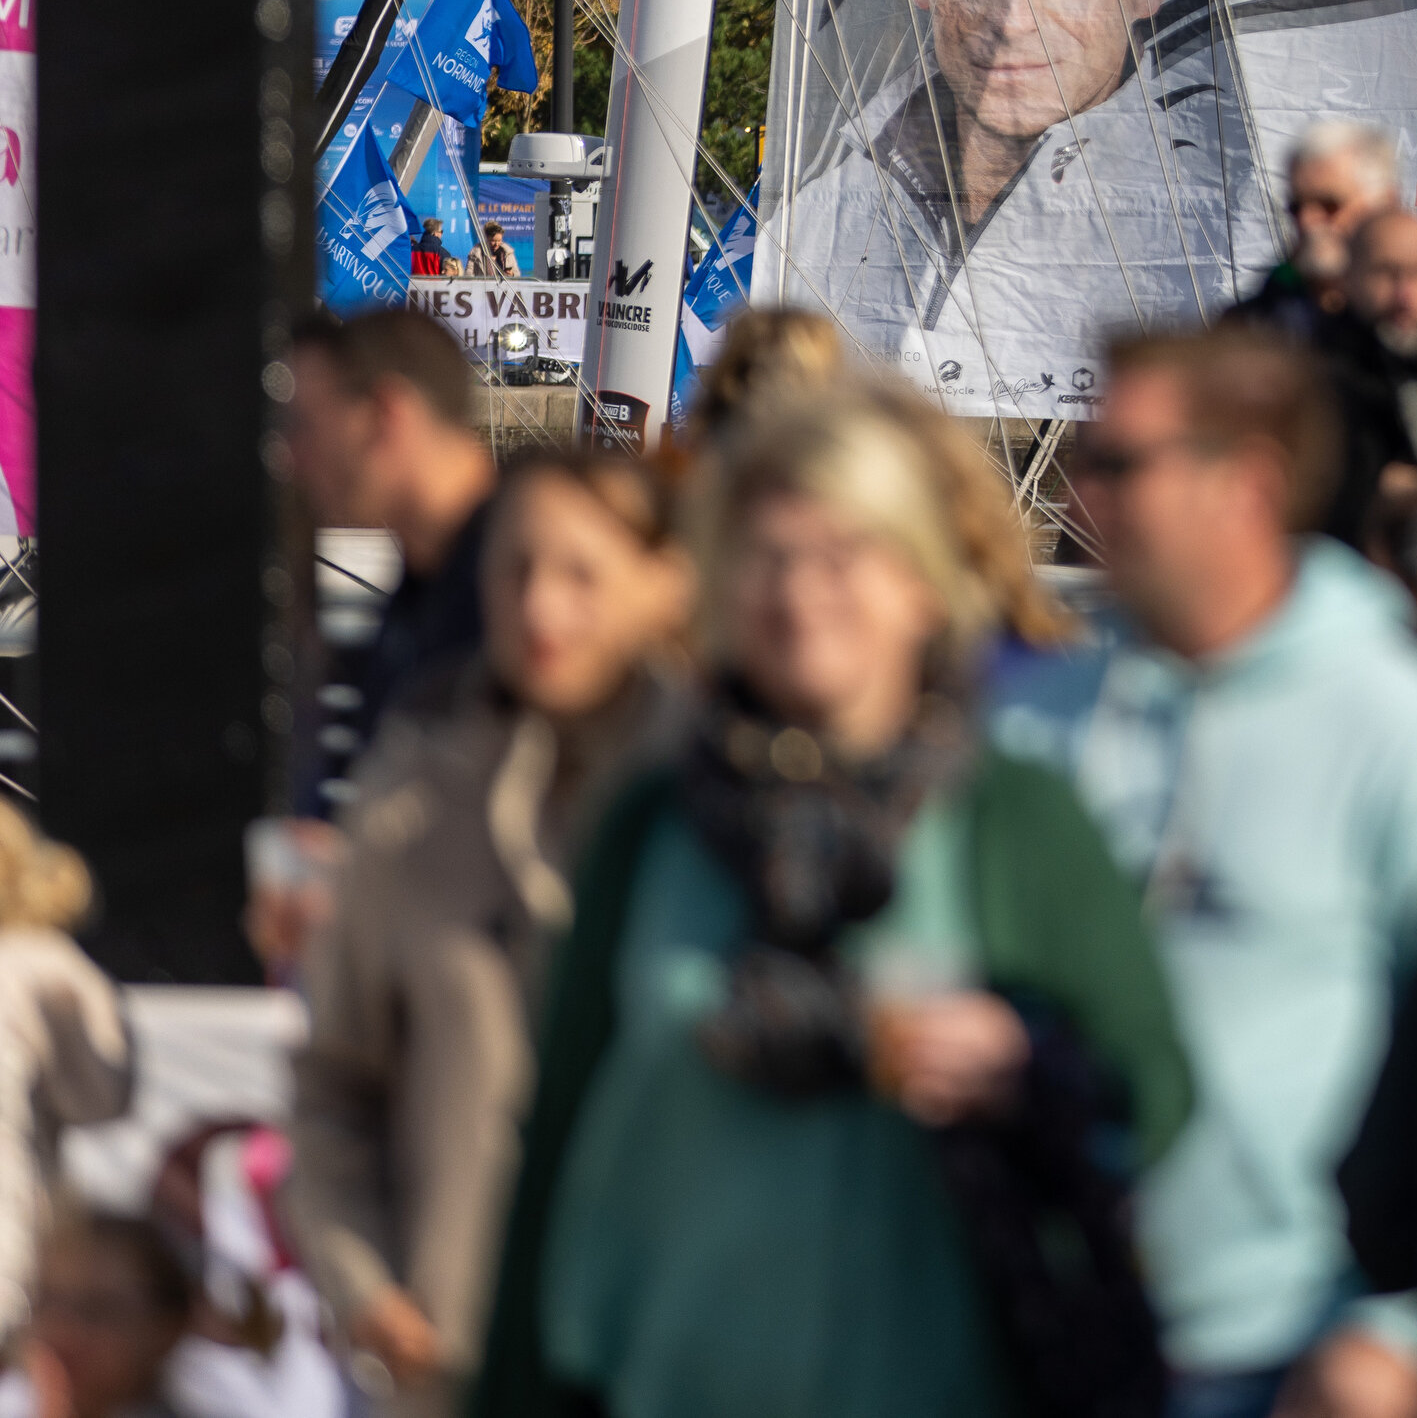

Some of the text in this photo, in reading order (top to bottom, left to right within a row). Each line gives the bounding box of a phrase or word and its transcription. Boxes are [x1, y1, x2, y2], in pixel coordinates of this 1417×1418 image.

[486, 291, 590, 320] VABR
[598, 301, 651, 324] VAINCRE
[924, 385, 975, 396] NeoCycle
